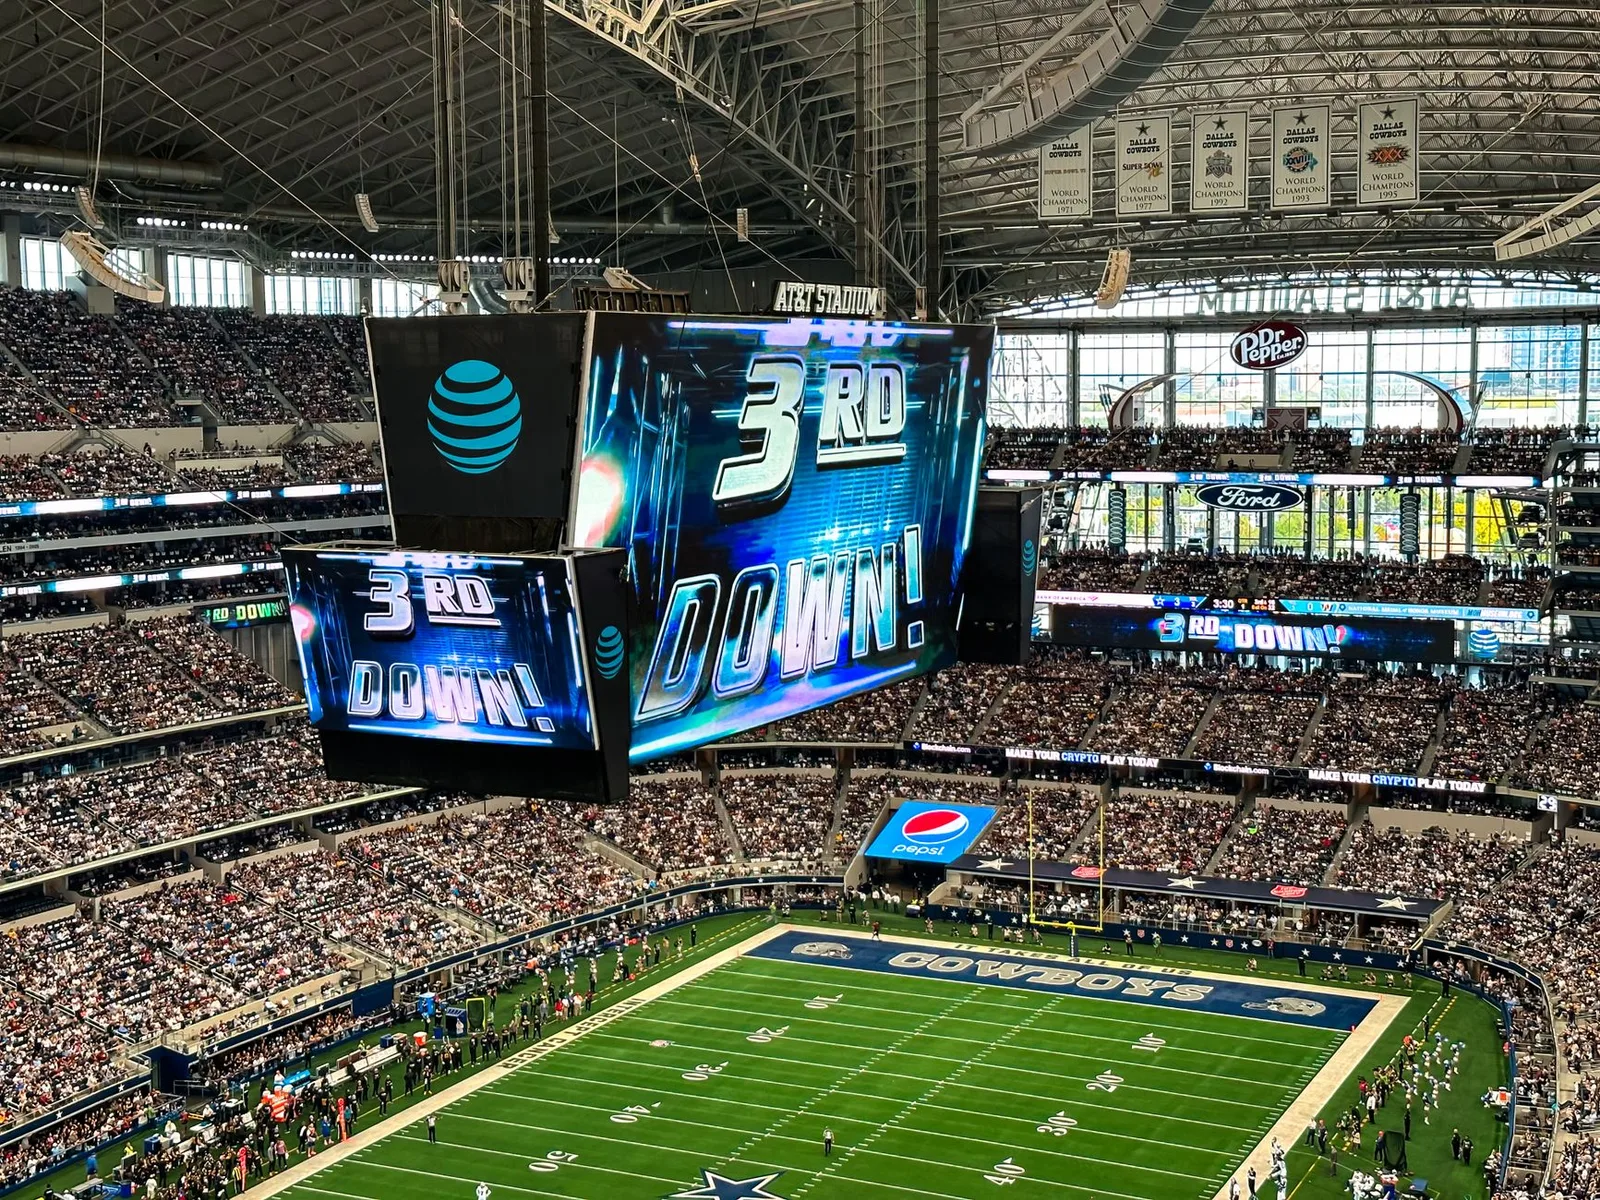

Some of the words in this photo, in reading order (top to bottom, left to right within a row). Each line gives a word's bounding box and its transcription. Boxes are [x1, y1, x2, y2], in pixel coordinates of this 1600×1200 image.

[1374, 122, 1404, 131] DALLAS
[1286, 127, 1316, 136] DALLAS
[1369, 130, 1408, 139] COWBOYS
[1129, 138, 1157, 146] DALLAS
[1283, 135, 1319, 144] COWBOYS
[1202, 140, 1237, 149] COWBOYS
[1049, 150, 1082, 158] COWBOYS
[1126, 145, 1160, 154] COWBOYS
[1122, 162, 1142, 171] SUPER
[1285, 177, 1316, 185] WORLD
[1372, 172, 1404, 181] WORLD
[1204, 181, 1234, 189] WORLD
[1362, 181, 1414, 191] CHAMPIONS
[1051, 189, 1079, 197] WORLD
[1129, 186, 1158, 194] WORLD
[1195, 189, 1243, 198] CHAMPIONS
[1276, 185, 1326, 195] CHAMPIONS
[1120, 193, 1167, 203] CHAMPIONS
[1291, 195, 1310, 203] 1993
[1379, 191, 1398, 199] 1995
[1043, 197, 1088, 206] CHAMPIONS
[1210, 198, 1228, 206] 1992
[1135, 203, 1152, 211] 1977
[774, 281, 815, 312] AT&T
[815, 284, 879, 316] STADIUM
[1258, 328, 1285, 347] Dr
[1217, 486, 1280, 507] Ford
[1174, 597, 1180, 606] 3
[1213, 599, 1234, 608] 3:30
[236, 600, 287, 620] DOWN!
[634, 524, 923, 721] DOWN!
[1235, 624, 1340, 654] DOWN!
[347, 660, 555, 732] DOWN!
[921, 743, 971, 753] Blockchain.com
[1005, 748, 1033, 759] MAKE
[1035, 750, 1060, 761] YOUR
[1062, 751, 1099, 763] CRYPTO
[1101, 754, 1126, 765] PLAY
[1127, 757, 1159, 768] TODAY
[1213, 763, 1269, 775] Blockchain.com
[1309, 770, 1340, 781] MAKE
[1342, 772, 1372, 783] YOUR
[1373, 774, 1416, 787] CRYPTO
[1418, 778, 1446, 789] PLAY
[1449, 780, 1486, 792] TODAY
[892, 844, 945, 856] pepsi
[888, 951, 1214, 1002] COWBOYS
[564, 998, 646, 1037] INTERCEPT
[499, 1037, 567, 1069] CANCER
[528, 1150, 579, 1172] 50
